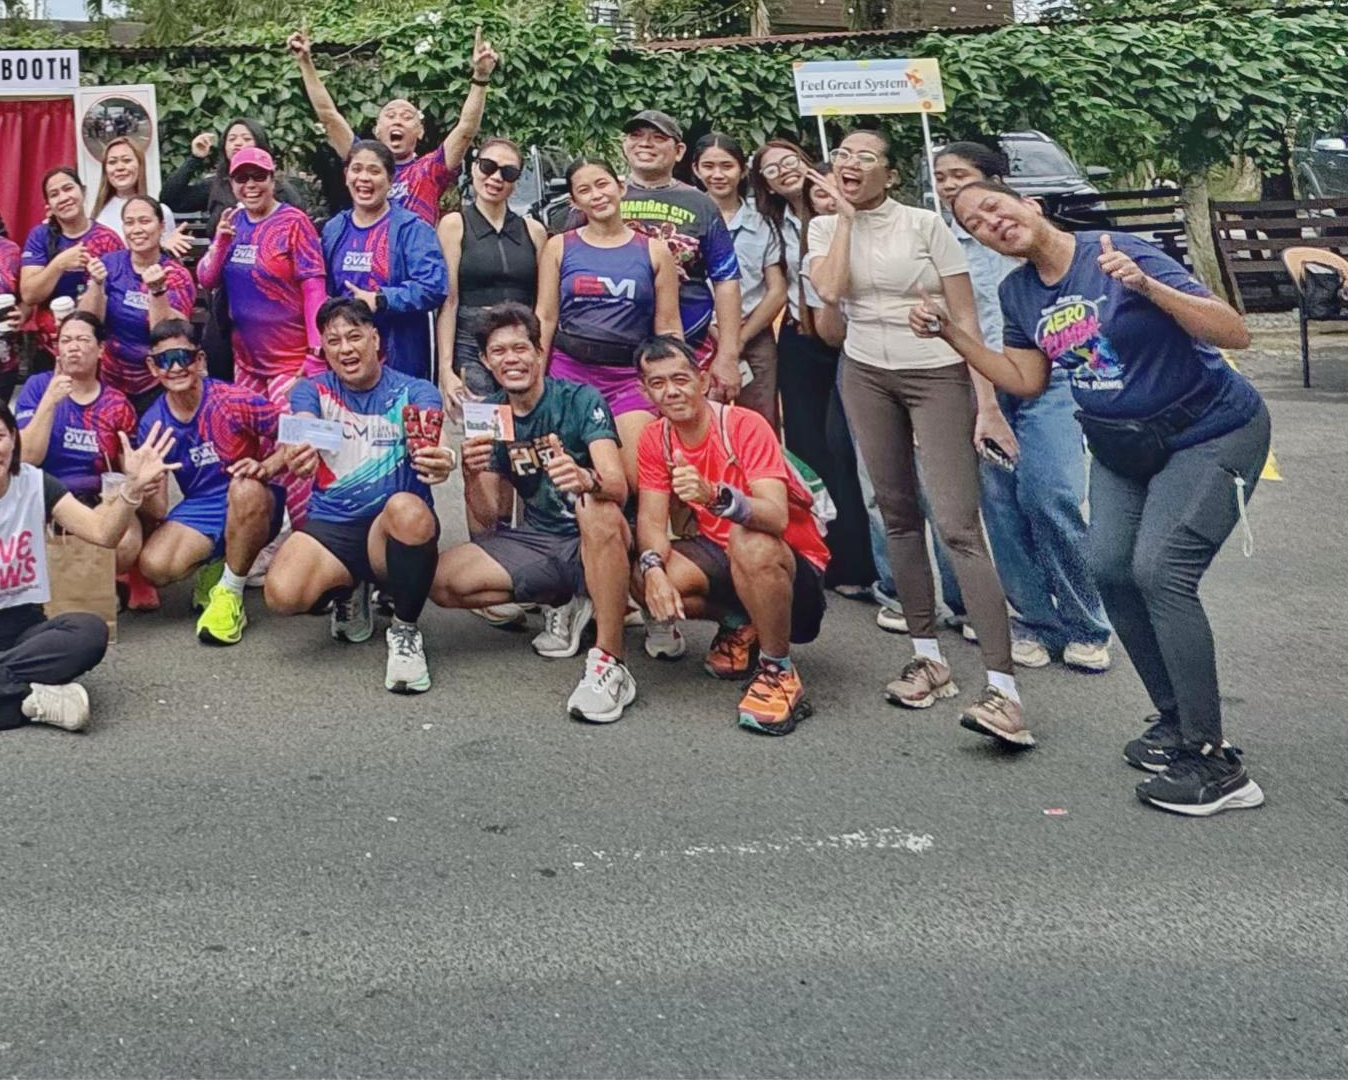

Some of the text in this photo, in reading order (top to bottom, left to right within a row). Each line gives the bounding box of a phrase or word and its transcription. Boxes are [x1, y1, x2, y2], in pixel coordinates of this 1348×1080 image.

[800, 77, 908, 92] Feel Great System
[670, 205, 696, 224] CITY
[1043, 304, 1086, 337] AERO
[64, 431, 99, 445] OVAL
